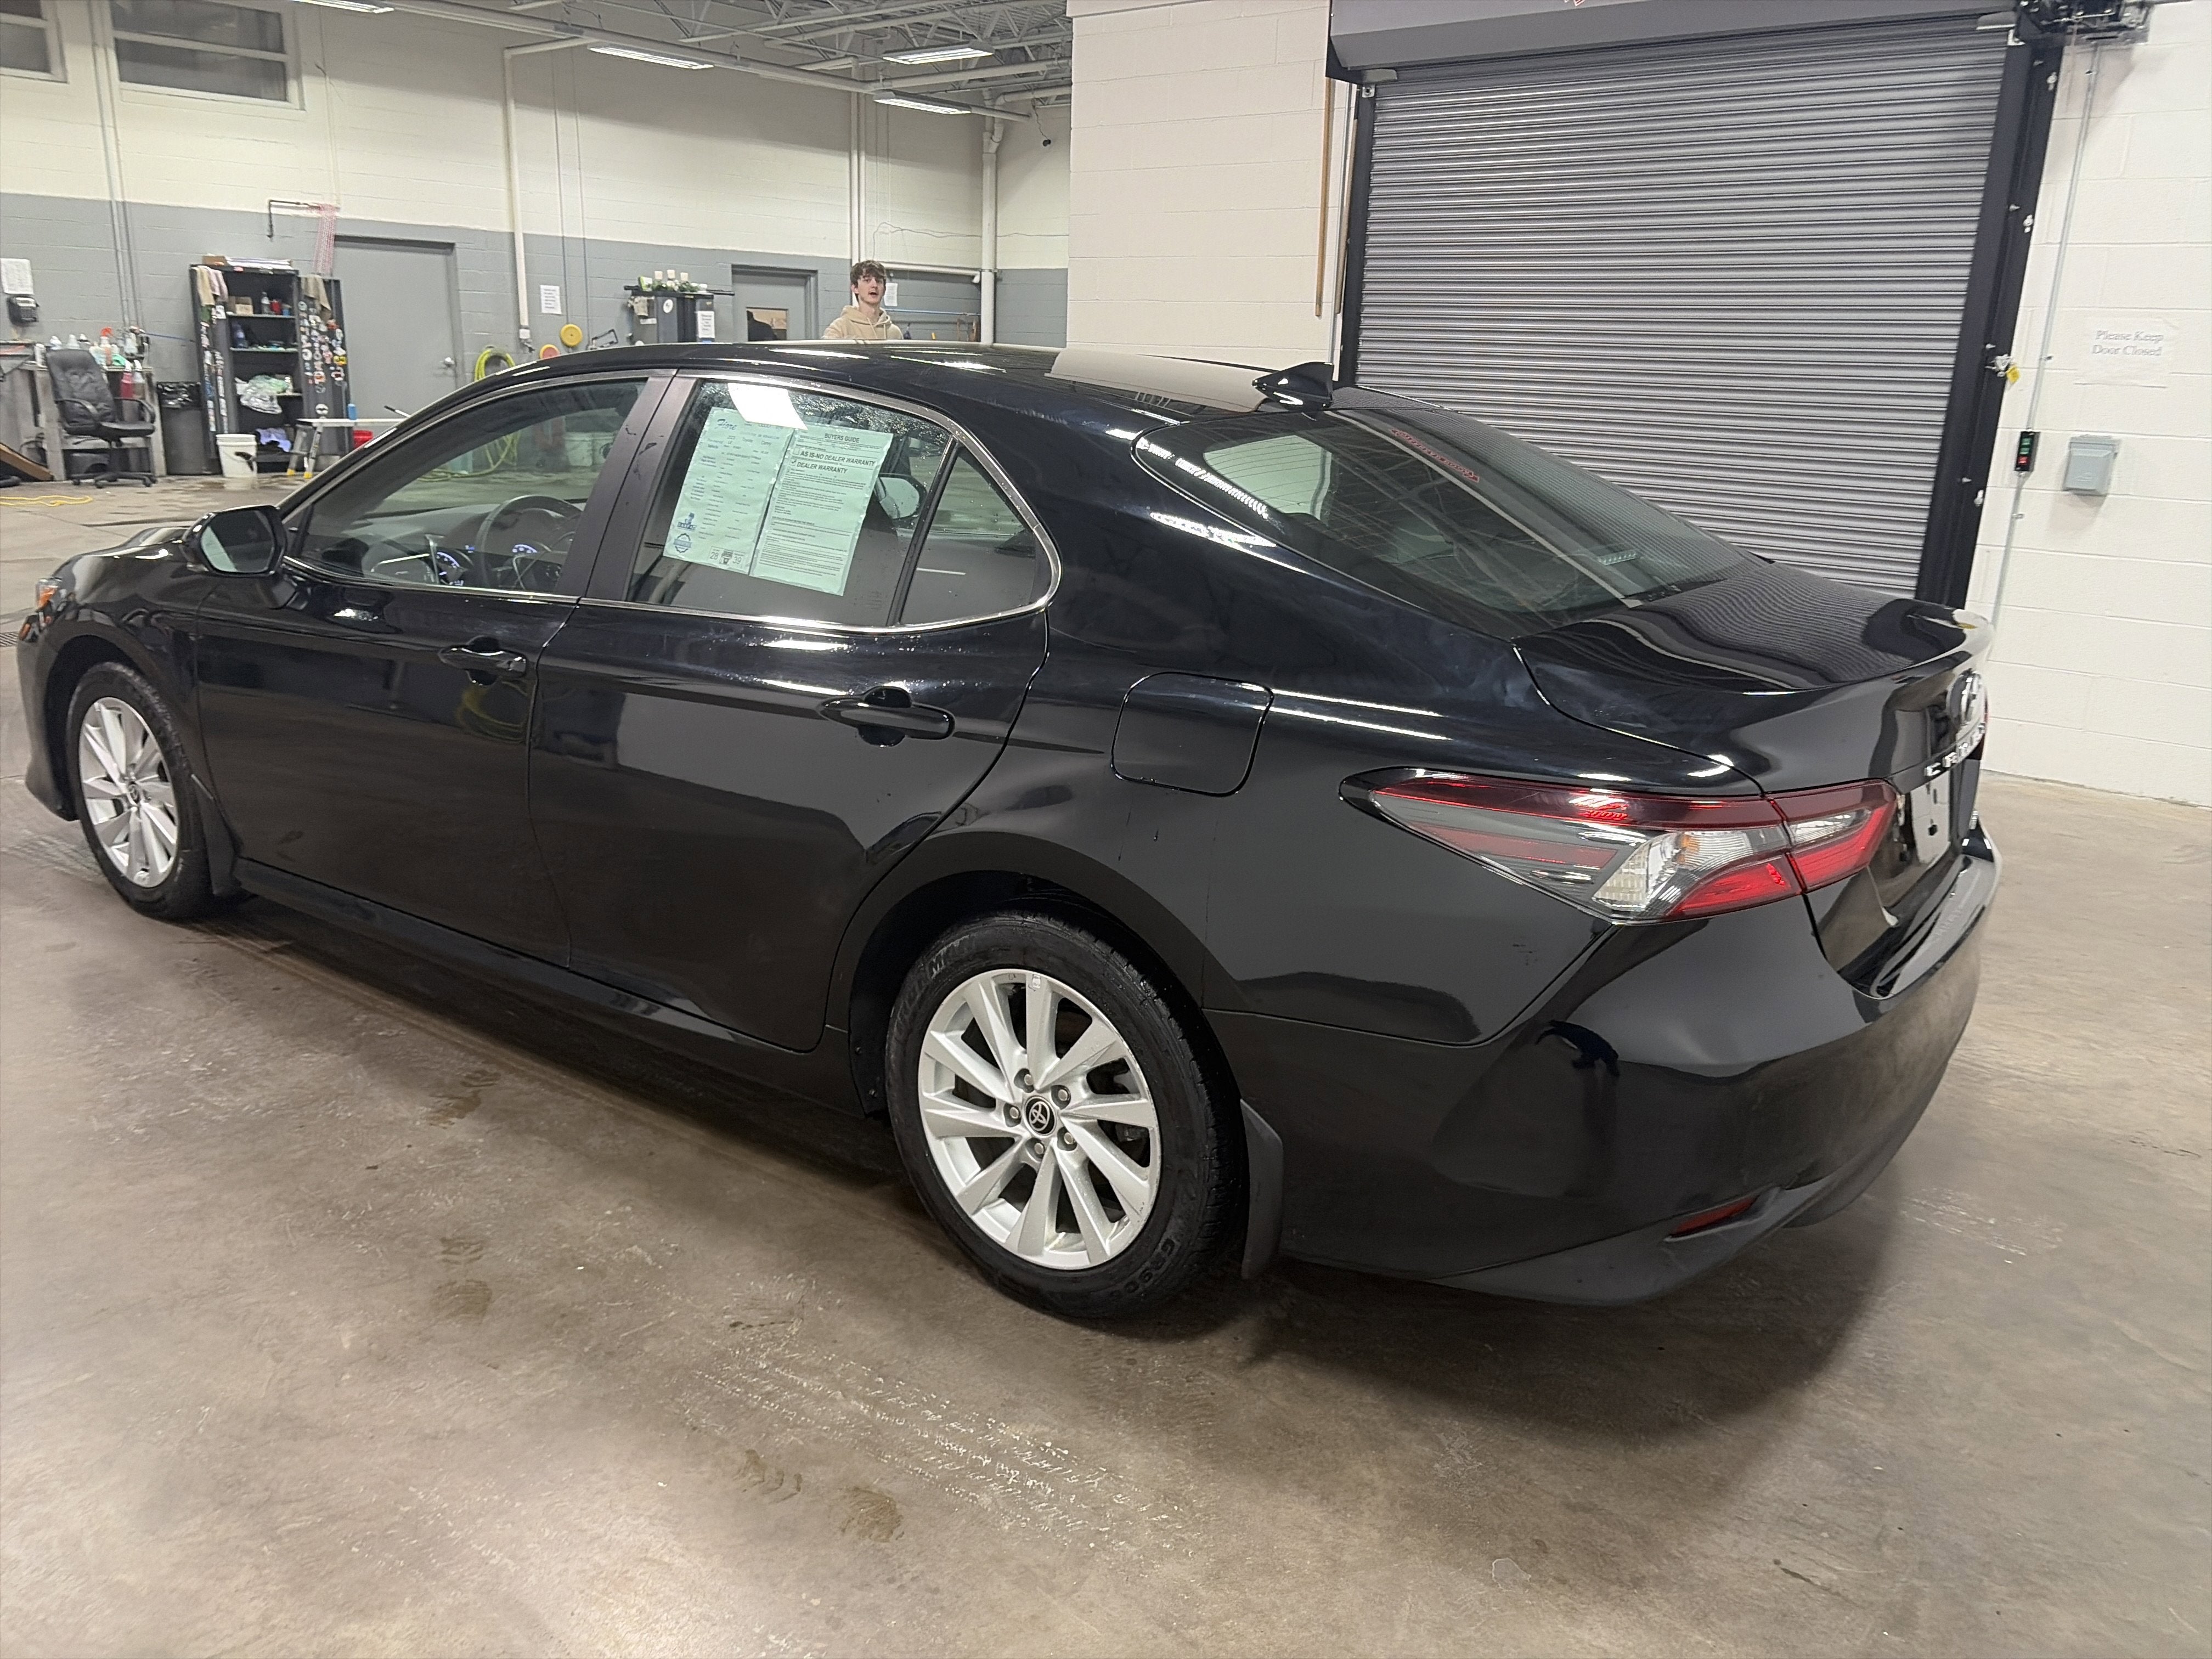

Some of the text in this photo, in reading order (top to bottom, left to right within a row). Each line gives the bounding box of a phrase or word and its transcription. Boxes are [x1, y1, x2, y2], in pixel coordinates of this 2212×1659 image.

[2095, 330, 2164, 343] Please Keep
[2092, 345, 2163, 356] Door Closed
[714, 419, 737, 431] Fiore
[825, 433, 844, 441] BUYERS
[825, 454, 845, 462] DEALER
[846, 457, 876, 466] WARRANTY
[797, 461, 848, 474] DEALER WARRANTY
[709, 551, 742, 565] 28 39
